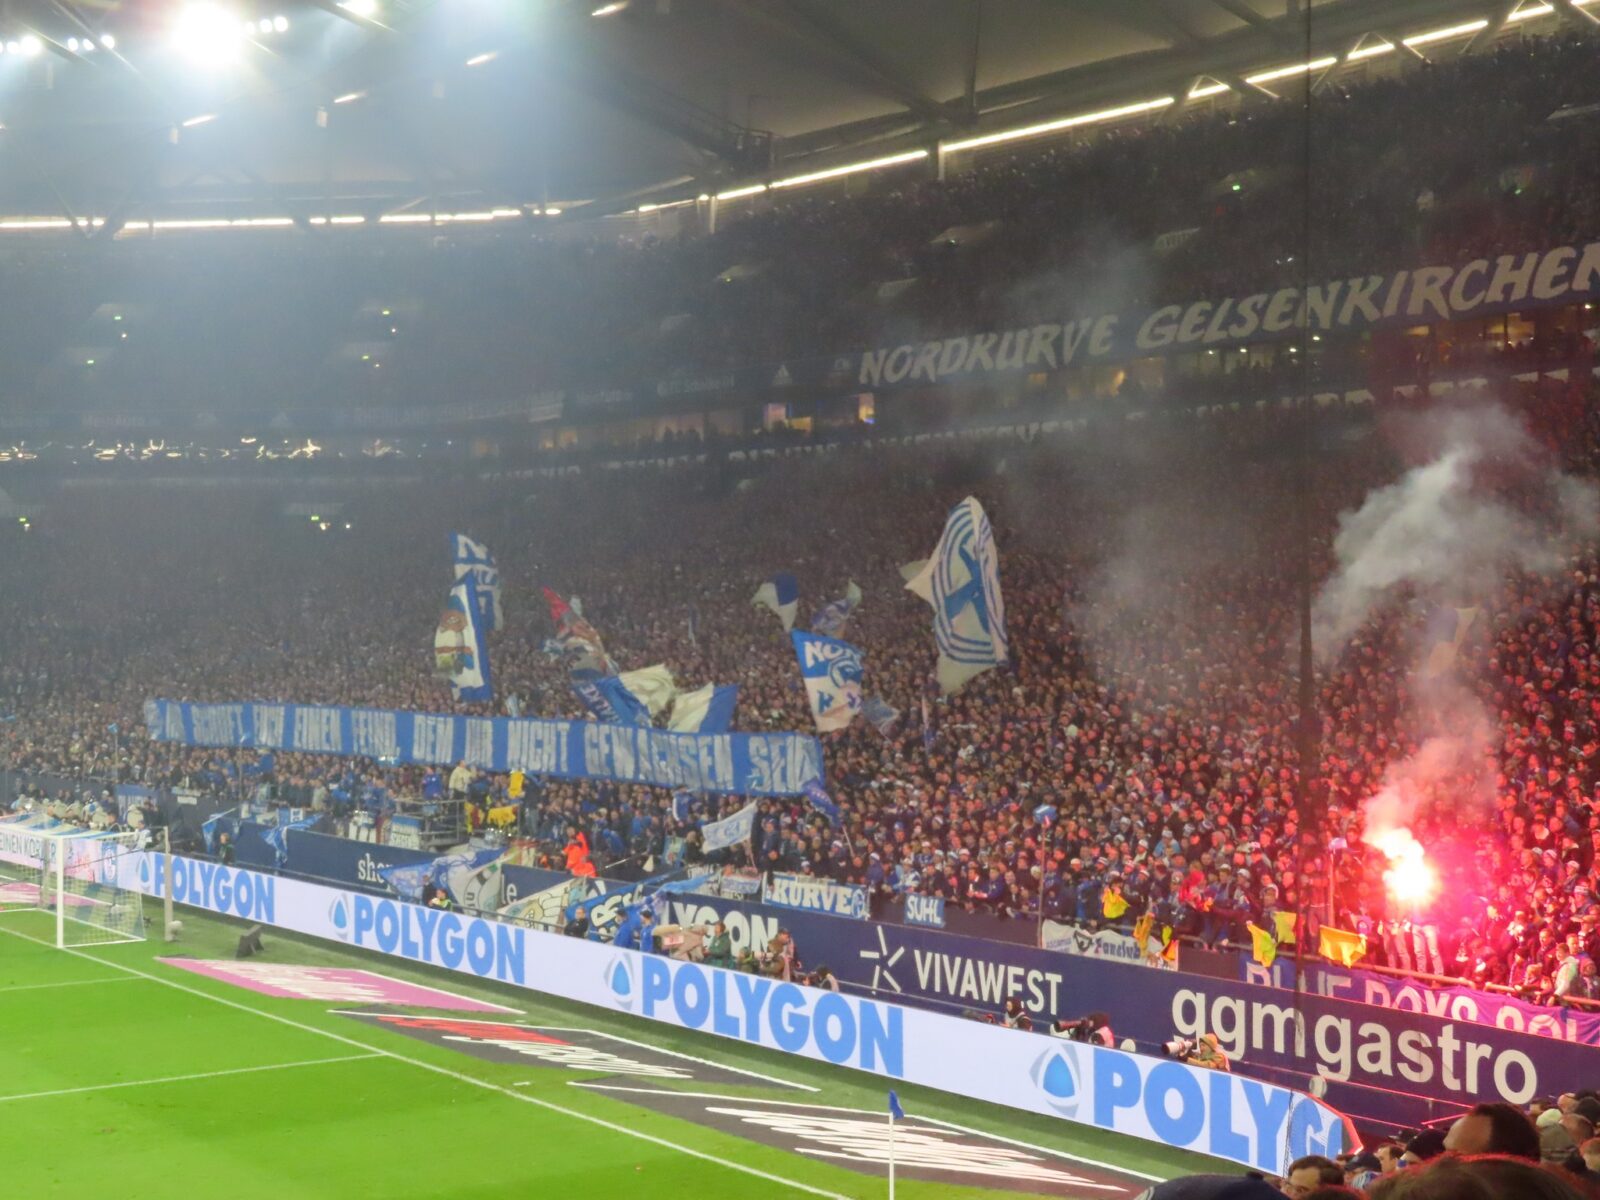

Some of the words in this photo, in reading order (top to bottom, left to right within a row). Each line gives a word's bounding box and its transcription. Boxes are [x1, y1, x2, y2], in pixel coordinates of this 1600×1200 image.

[858, 314, 1119, 387] NORDKURVE
[507, 721, 570, 773] NICHT
[584, 723, 734, 790] GEWACHSEN
[154, 853, 275, 923] POLYGON
[772, 879, 851, 918] KURVE
[906, 896, 943, 924] SUHL
[354, 895, 525, 985] POLYGON
[642, 955, 904, 1078] POLYGON
[914, 950, 1062, 1015] VIVAWEST
[1172, 989, 1538, 1104] ggmgastro
